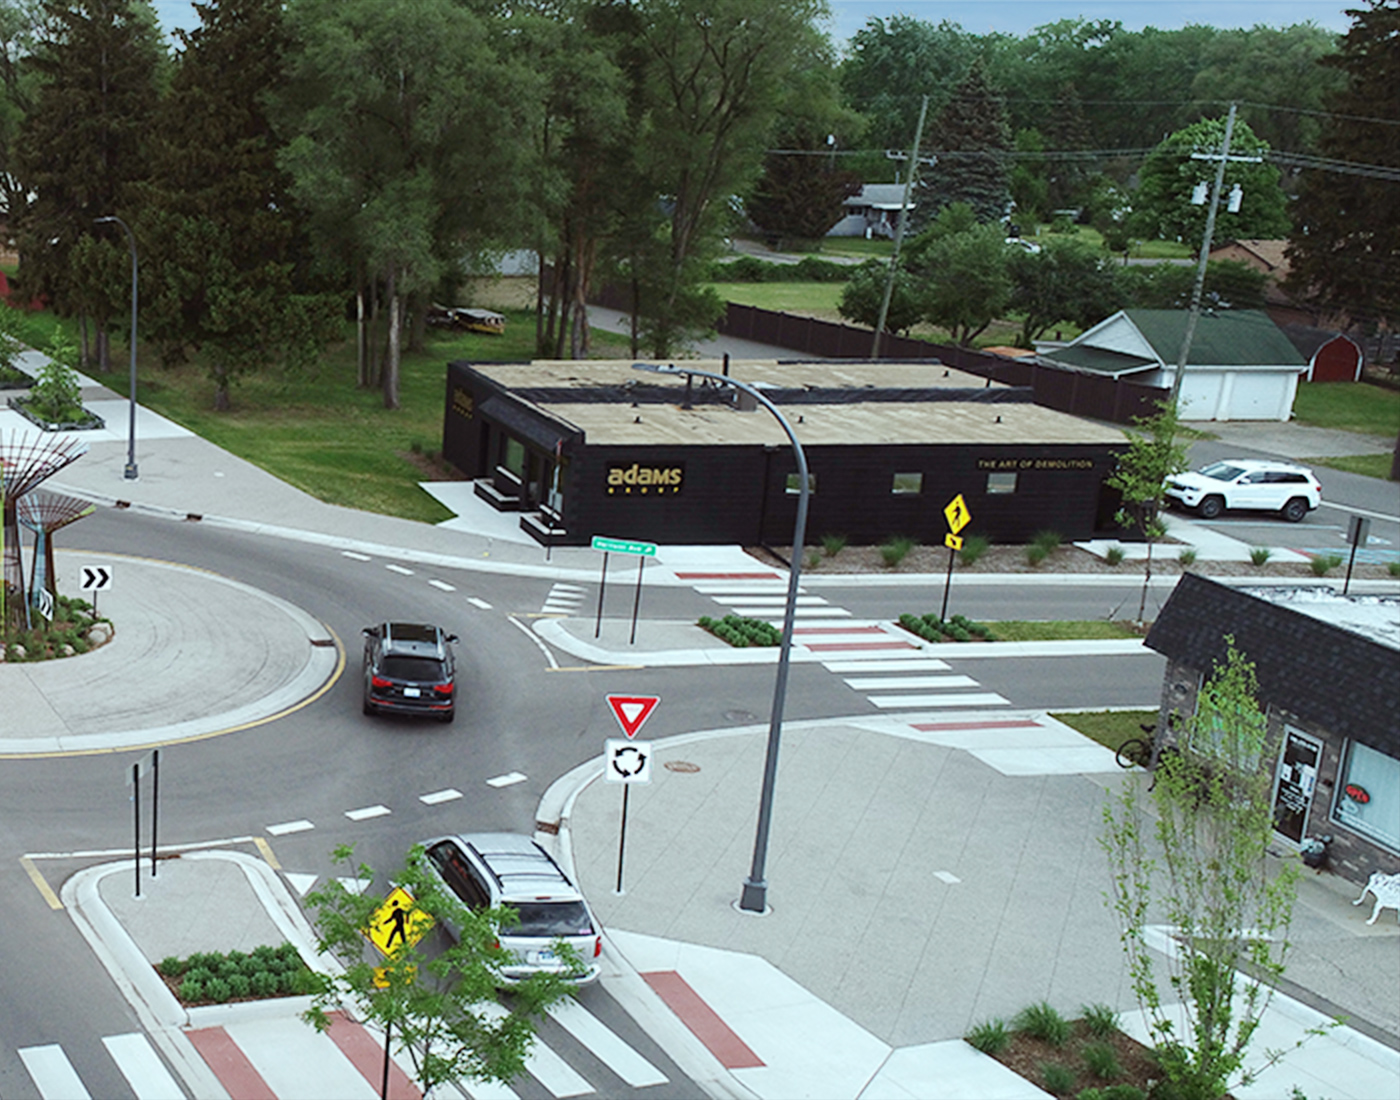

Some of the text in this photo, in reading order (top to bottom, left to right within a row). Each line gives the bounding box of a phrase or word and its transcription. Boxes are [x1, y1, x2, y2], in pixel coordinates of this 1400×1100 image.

[978, 460, 1093, 468] THE ART OF DEMOLITION
[1346, 784, 1369, 803] OPEN
